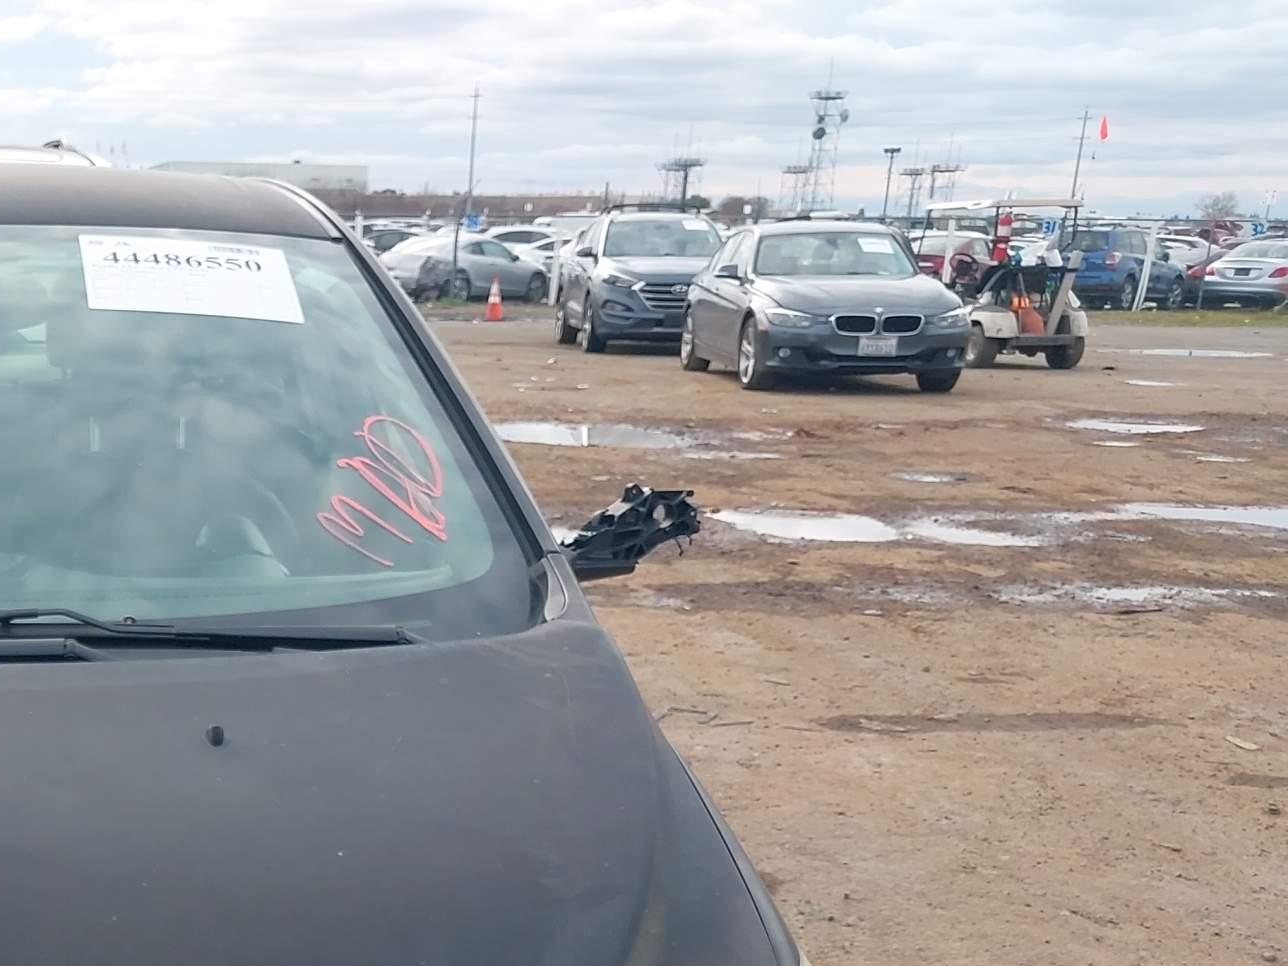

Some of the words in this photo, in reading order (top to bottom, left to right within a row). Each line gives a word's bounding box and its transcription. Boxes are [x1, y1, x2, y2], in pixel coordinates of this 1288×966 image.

[1043, 220, 1057, 234] 31
[1251, 223, 1266, 237] 32
[103, 250, 263, 273] 44486550
